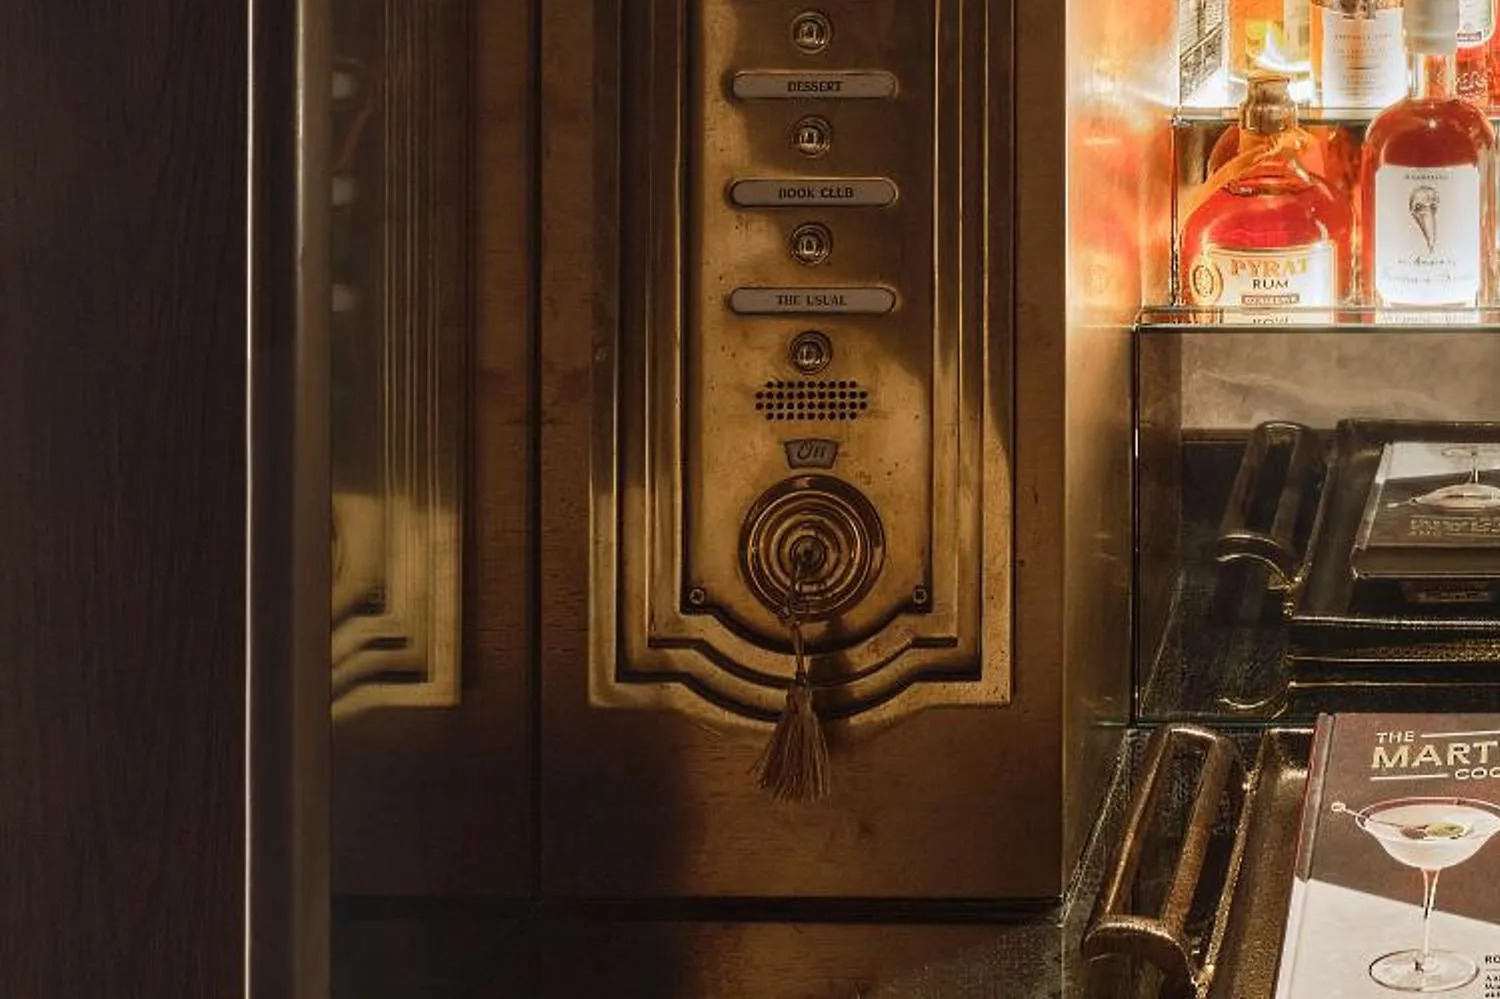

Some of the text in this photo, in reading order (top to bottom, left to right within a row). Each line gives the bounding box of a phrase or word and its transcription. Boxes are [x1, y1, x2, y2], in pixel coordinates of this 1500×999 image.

[787, 81, 844, 93] DESSERT
[778, 187, 855, 199] BOOK CLUB
[1230, 256, 1309, 278] PYRAT
[1252, 279, 1290, 290] RUM
[775, 295, 848, 306] THE USUAL
[1376, 731, 1415, 745] THE
